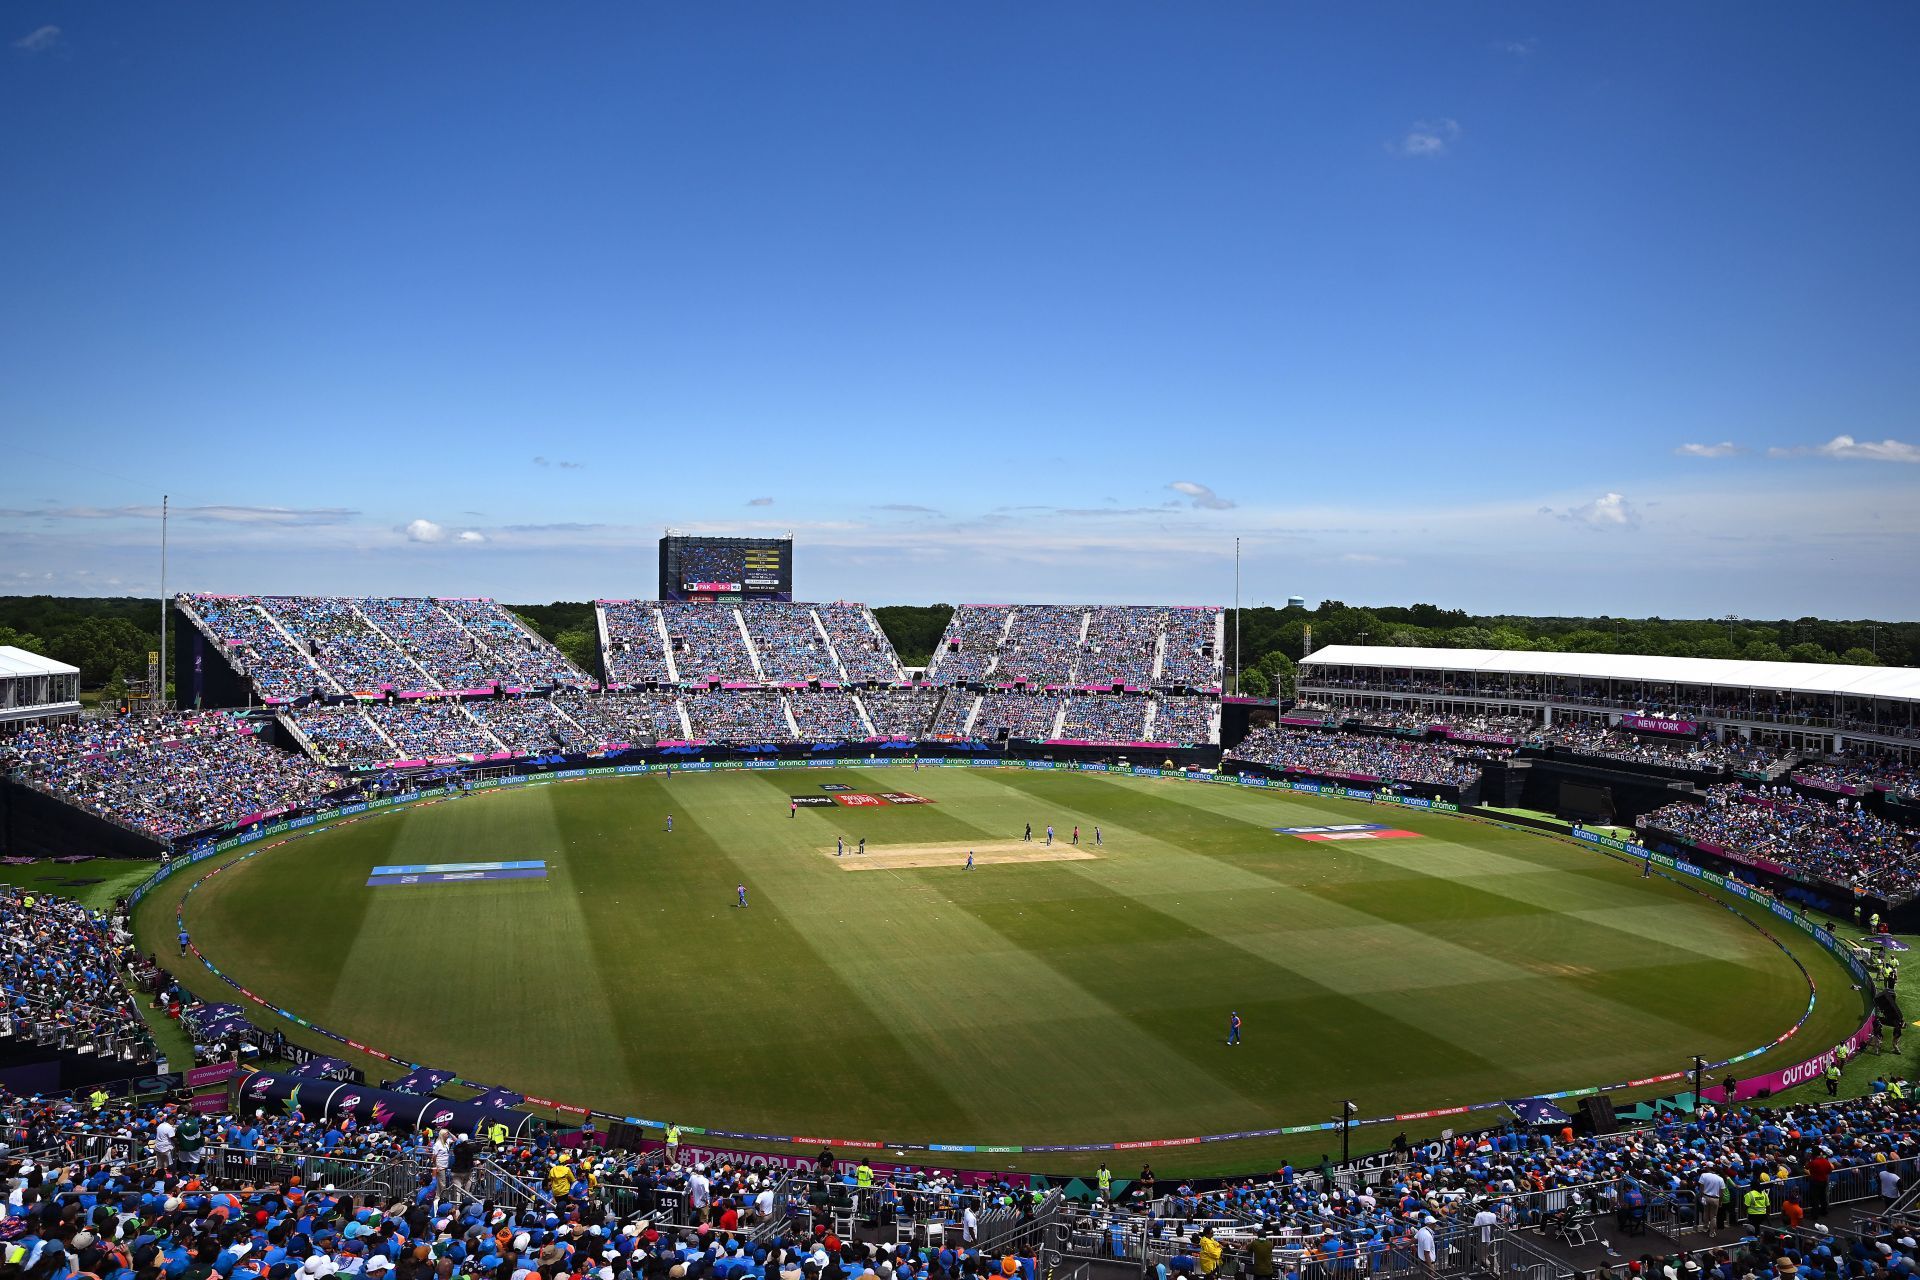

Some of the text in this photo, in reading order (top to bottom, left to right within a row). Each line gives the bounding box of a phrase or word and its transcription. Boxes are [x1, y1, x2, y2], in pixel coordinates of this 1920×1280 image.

[1638, 719, 1679, 731] NEW YORK
[529, 772, 554, 780] aramco
[557, 769, 584, 777] aramco
[474, 780, 497, 788] aramco
[500, 775, 525, 784] aramco
[1241, 778, 1264, 786] aramco
[1268, 780, 1290, 788] aramco
[421, 788, 445, 797] aramco
[1294, 783, 1317, 792] aramco
[1348, 788, 1372, 799] aramco
[369, 798, 391, 808] aramco
[394, 793, 418, 803] aramco
[1376, 792, 1400, 802] aramco
[1404, 796, 1428, 806] aramco
[343, 803, 365, 814] aramco
[1432, 801, 1456, 810] aramco
[290, 816, 314, 828] aramco
[317, 810, 339, 822] aramco
[266, 823, 288, 835] aramco
[240, 830, 263, 843] aramco
[1574, 830, 1598, 842] aramco
[217, 838, 238, 852] aramco
[1601, 837, 1624, 849] aramco
[192, 847, 214, 861] aramco
[1627, 844, 1648, 857] aramco
[172, 856, 190, 871] aramco
[1651, 853, 1674, 866] aramco
[156, 865, 170, 882] aramco
[1677, 861, 1700, 876] aramco
[1703, 870, 1724, 885] aramco
[1726, 881, 1747, 896] aramco
[1750, 891, 1770, 907] aramco
[1772, 902, 1792, 920] aramco
[1794, 915, 1813, 933] aramco
[1816, 929, 1833, 948] aramco
[192, 1066, 233, 1080] #T20WorldCup
[1782, 1050, 1834, 1085] OUT OF THIS
[114, 1144, 129, 1152] 152
[227, 1155, 242, 1164] 151
[660, 1198, 679, 1207] 151
